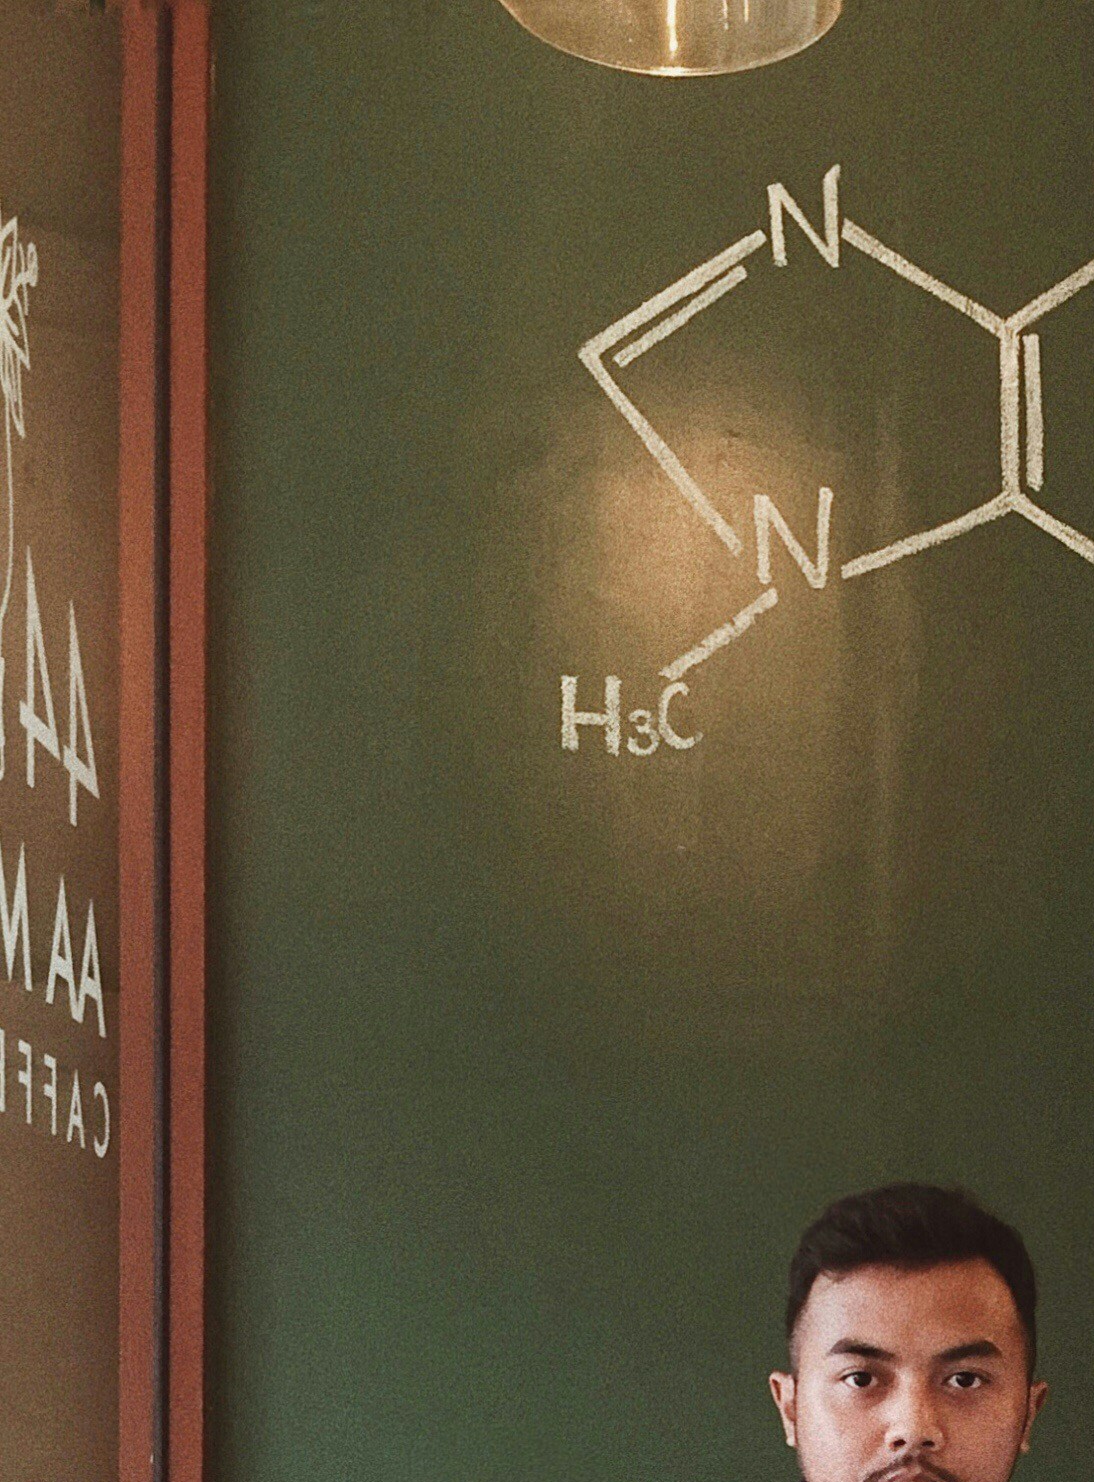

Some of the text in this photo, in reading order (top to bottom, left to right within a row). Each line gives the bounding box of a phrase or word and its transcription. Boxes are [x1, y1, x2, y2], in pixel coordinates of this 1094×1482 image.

[767, 163, 841, 268] N
[754, 486, 834, 590] N
[560, 673, 703, 758] H3C
